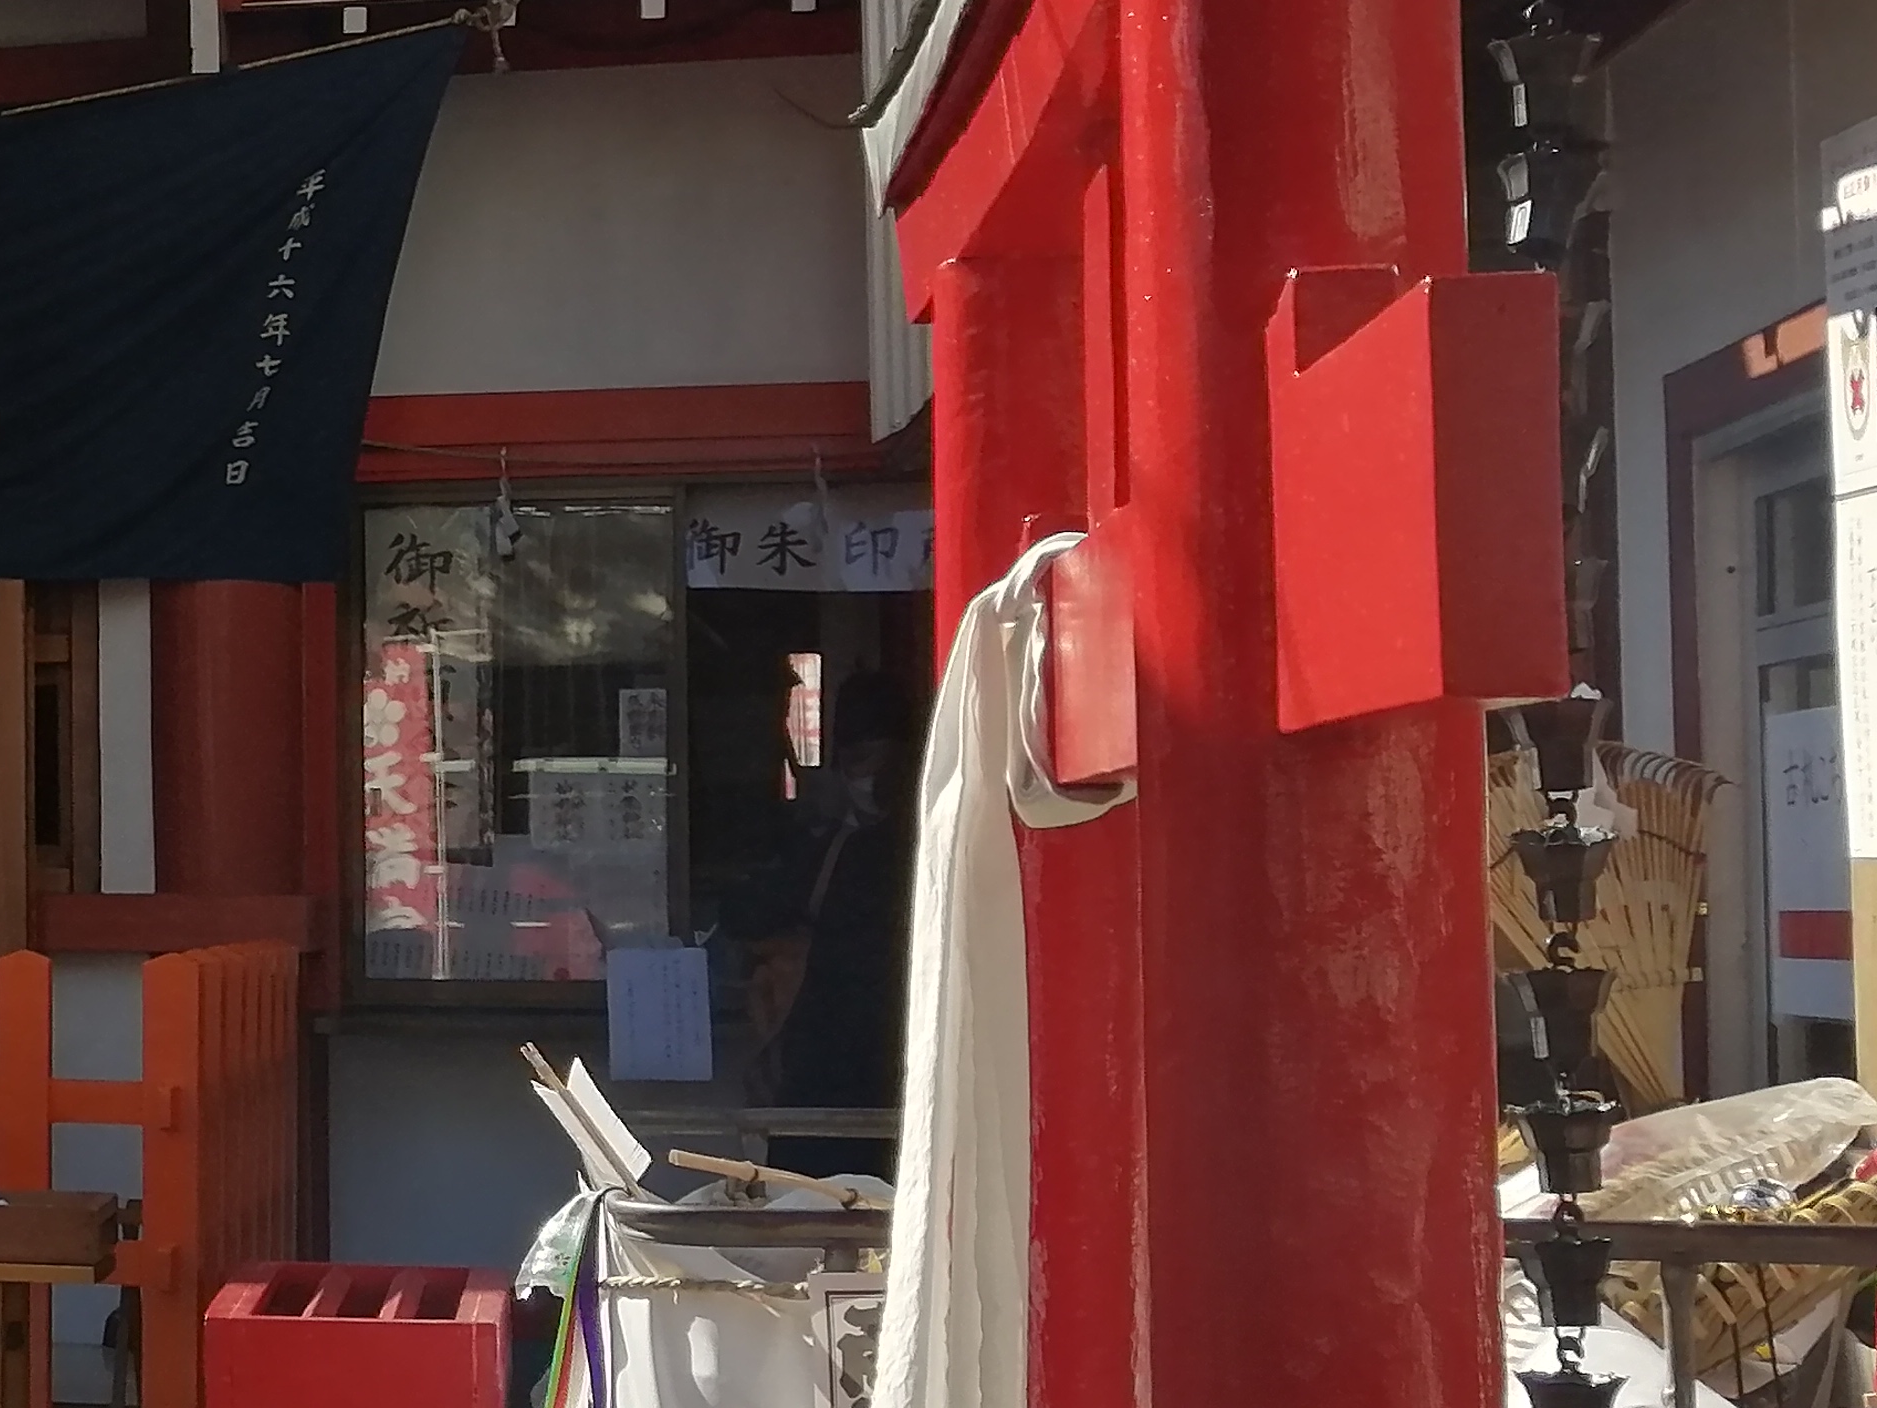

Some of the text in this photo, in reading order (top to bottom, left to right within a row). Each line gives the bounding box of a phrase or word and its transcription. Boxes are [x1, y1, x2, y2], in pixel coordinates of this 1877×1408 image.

[225, 169, 327, 485] 平成十六年七月吉日
[685, 518, 934, 577] 御朱印
